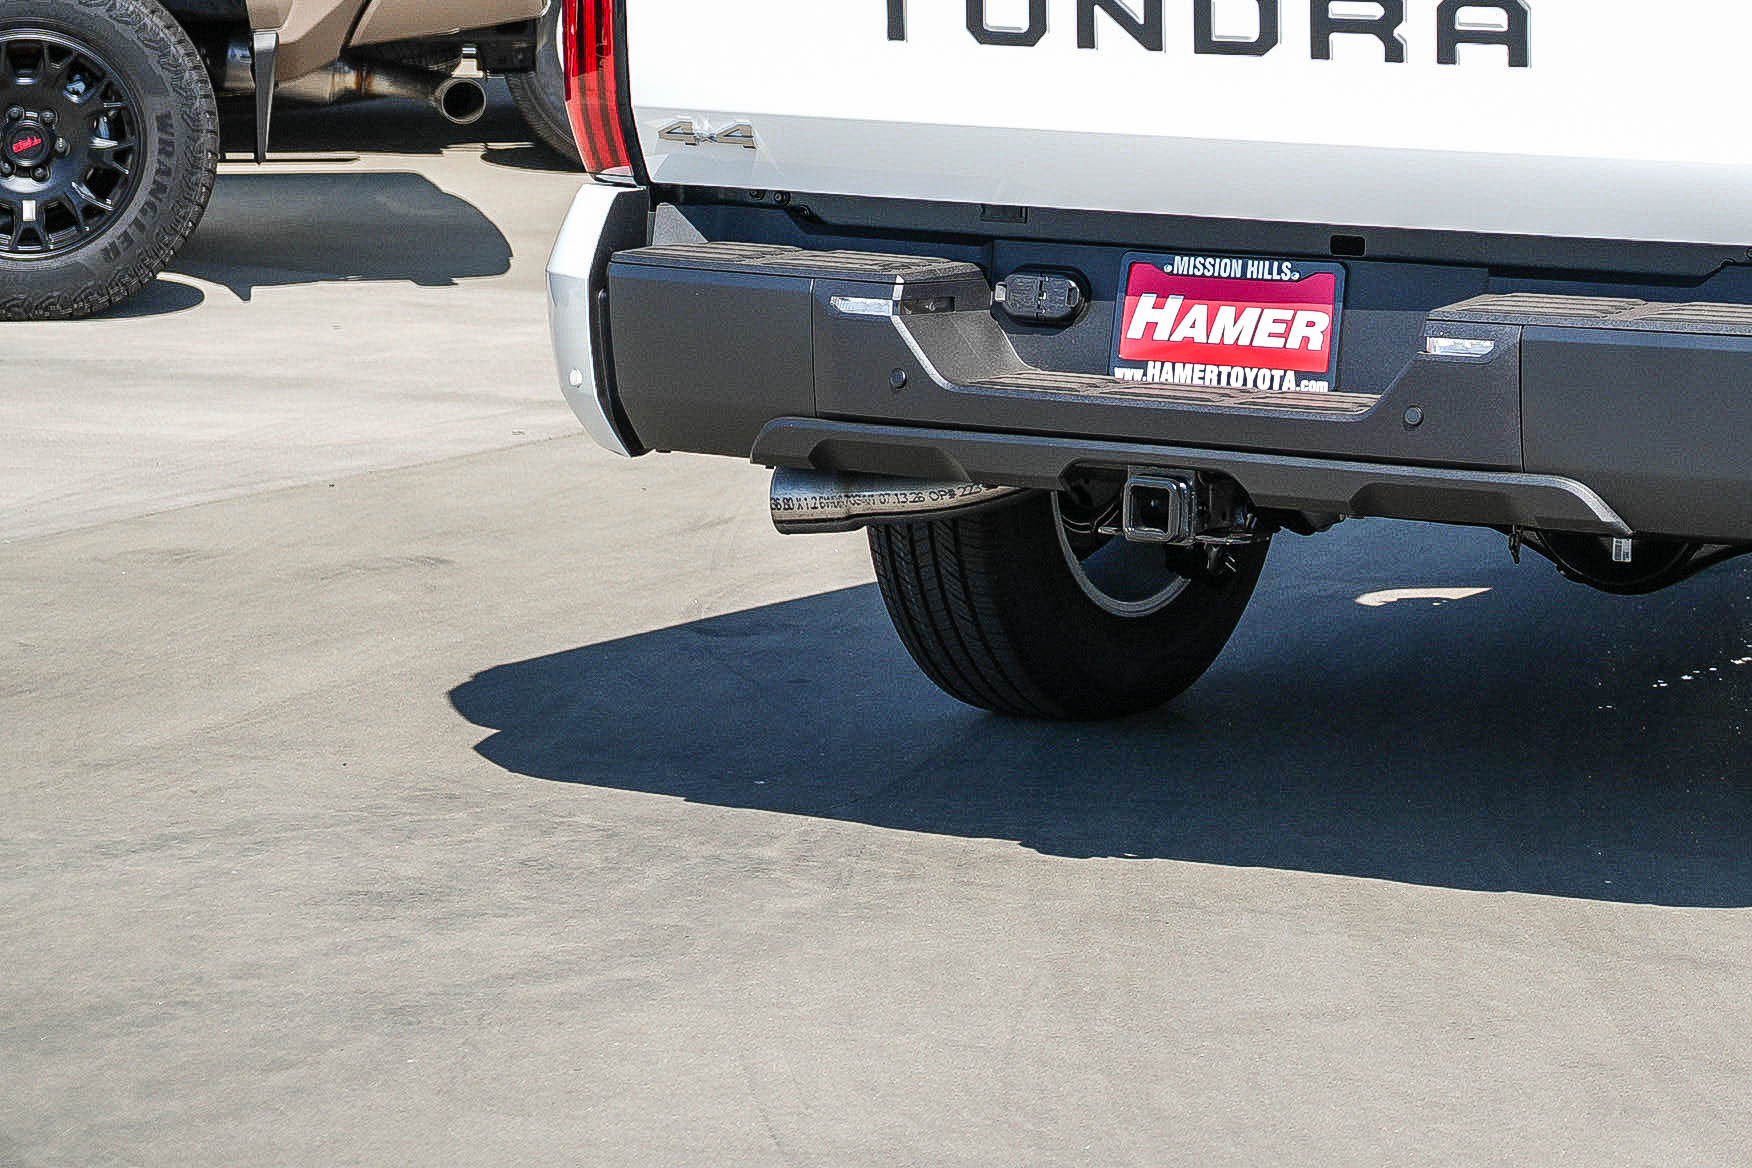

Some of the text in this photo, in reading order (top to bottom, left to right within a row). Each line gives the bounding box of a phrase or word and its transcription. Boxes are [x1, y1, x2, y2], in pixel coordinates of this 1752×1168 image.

[1172, 255, 1292, 281] MISSION HILLS
[1126, 293, 1331, 352] HAMER
[1114, 361, 1329, 393] www.HAMERTOYOTA.com
